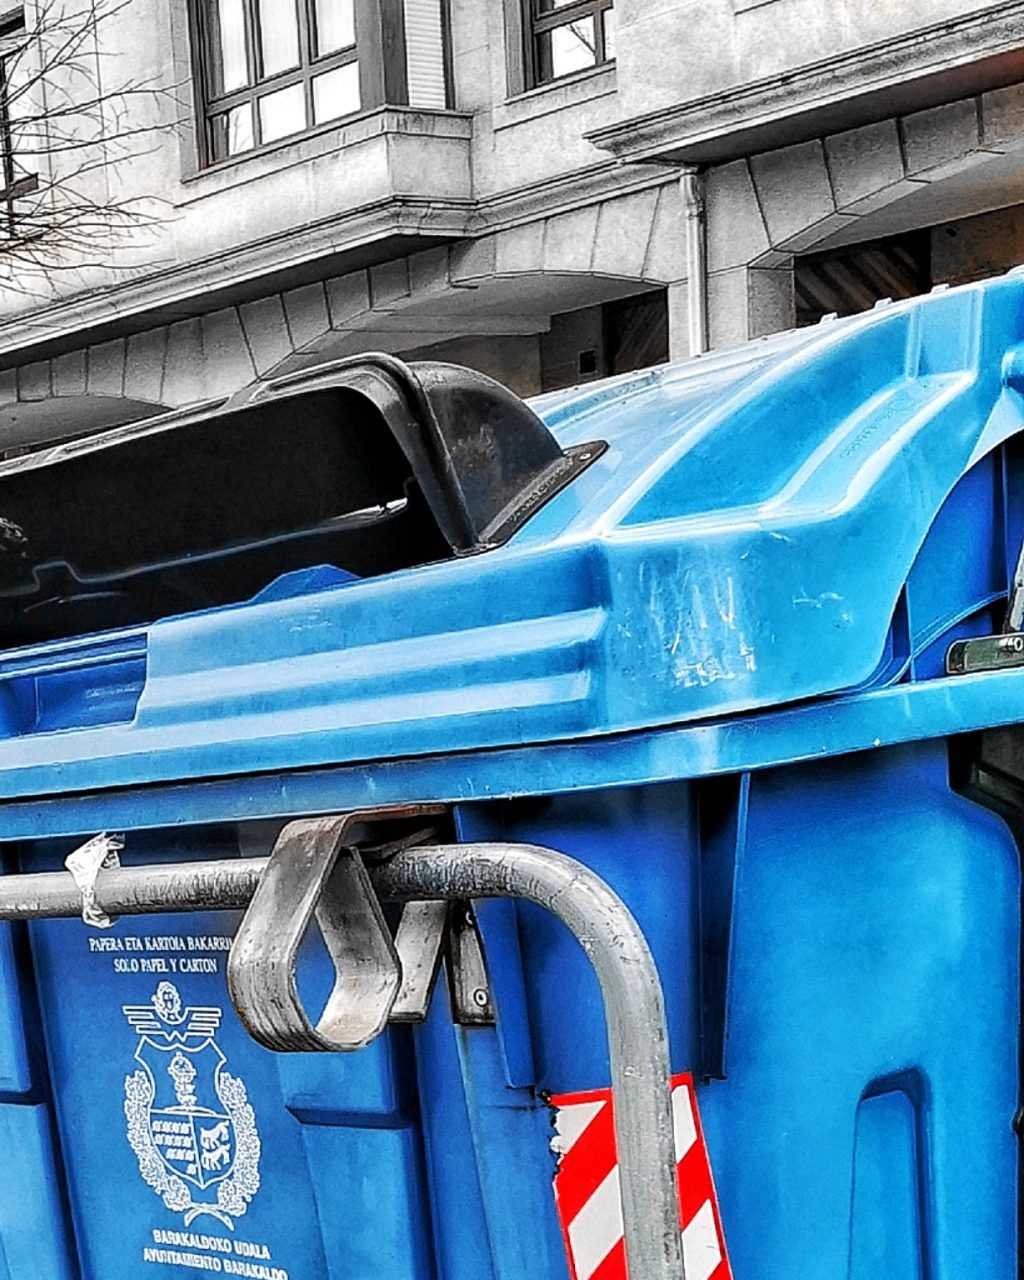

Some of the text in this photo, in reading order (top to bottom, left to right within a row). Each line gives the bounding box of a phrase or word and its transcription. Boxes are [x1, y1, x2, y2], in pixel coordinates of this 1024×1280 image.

[89, 937, 124, 951] PAPERA
[125, 936, 142, 950] ETA
[114, 958, 218, 972] SOLO PAPEL Y CARTON
[152, 1229, 271, 1260] BARAKALDOKO UDALA
[143, 1247, 222, 1271] AYUNTAMIENTO
